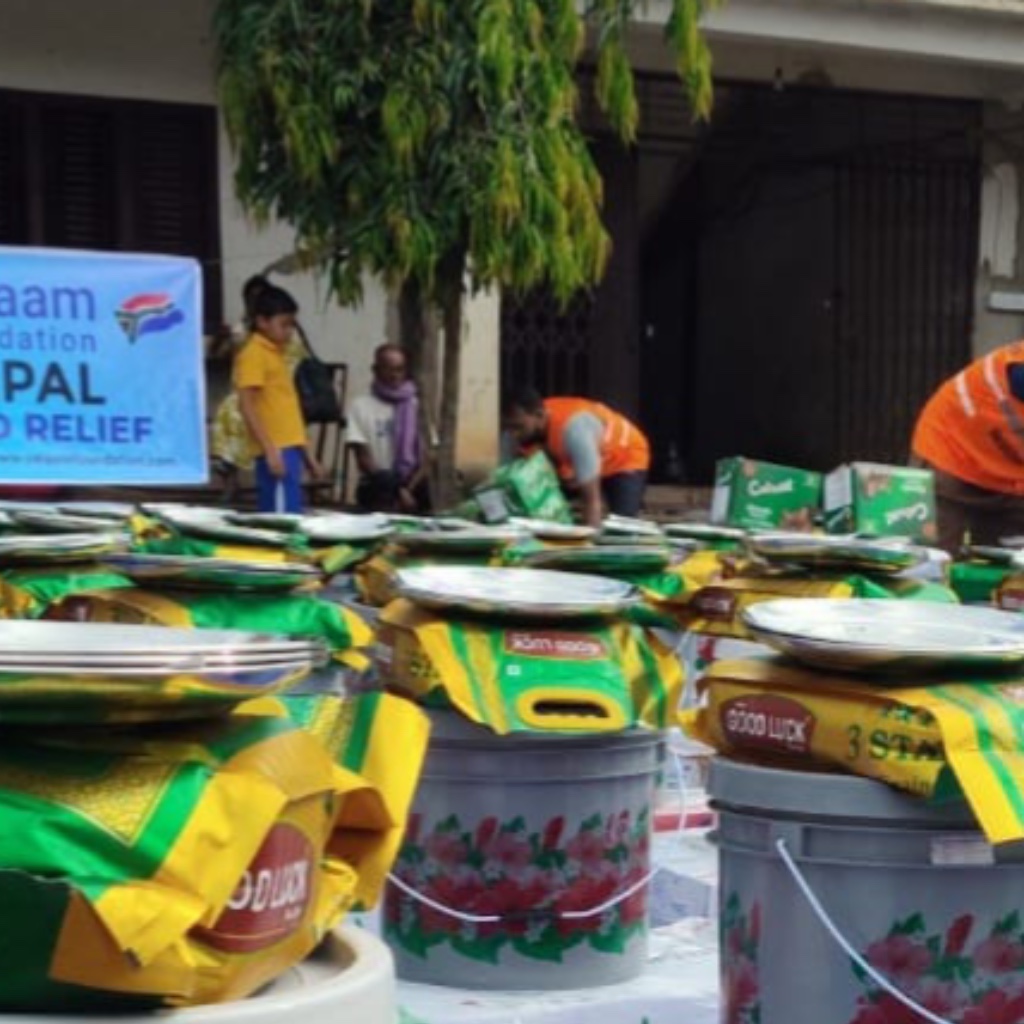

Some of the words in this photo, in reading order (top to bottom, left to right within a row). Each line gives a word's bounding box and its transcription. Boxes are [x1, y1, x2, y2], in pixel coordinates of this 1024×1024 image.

[24, 413, 153, 444] RELIEF
[727, 708, 767, 737] GOOD
[769, 714, 806, 743] LUCK
